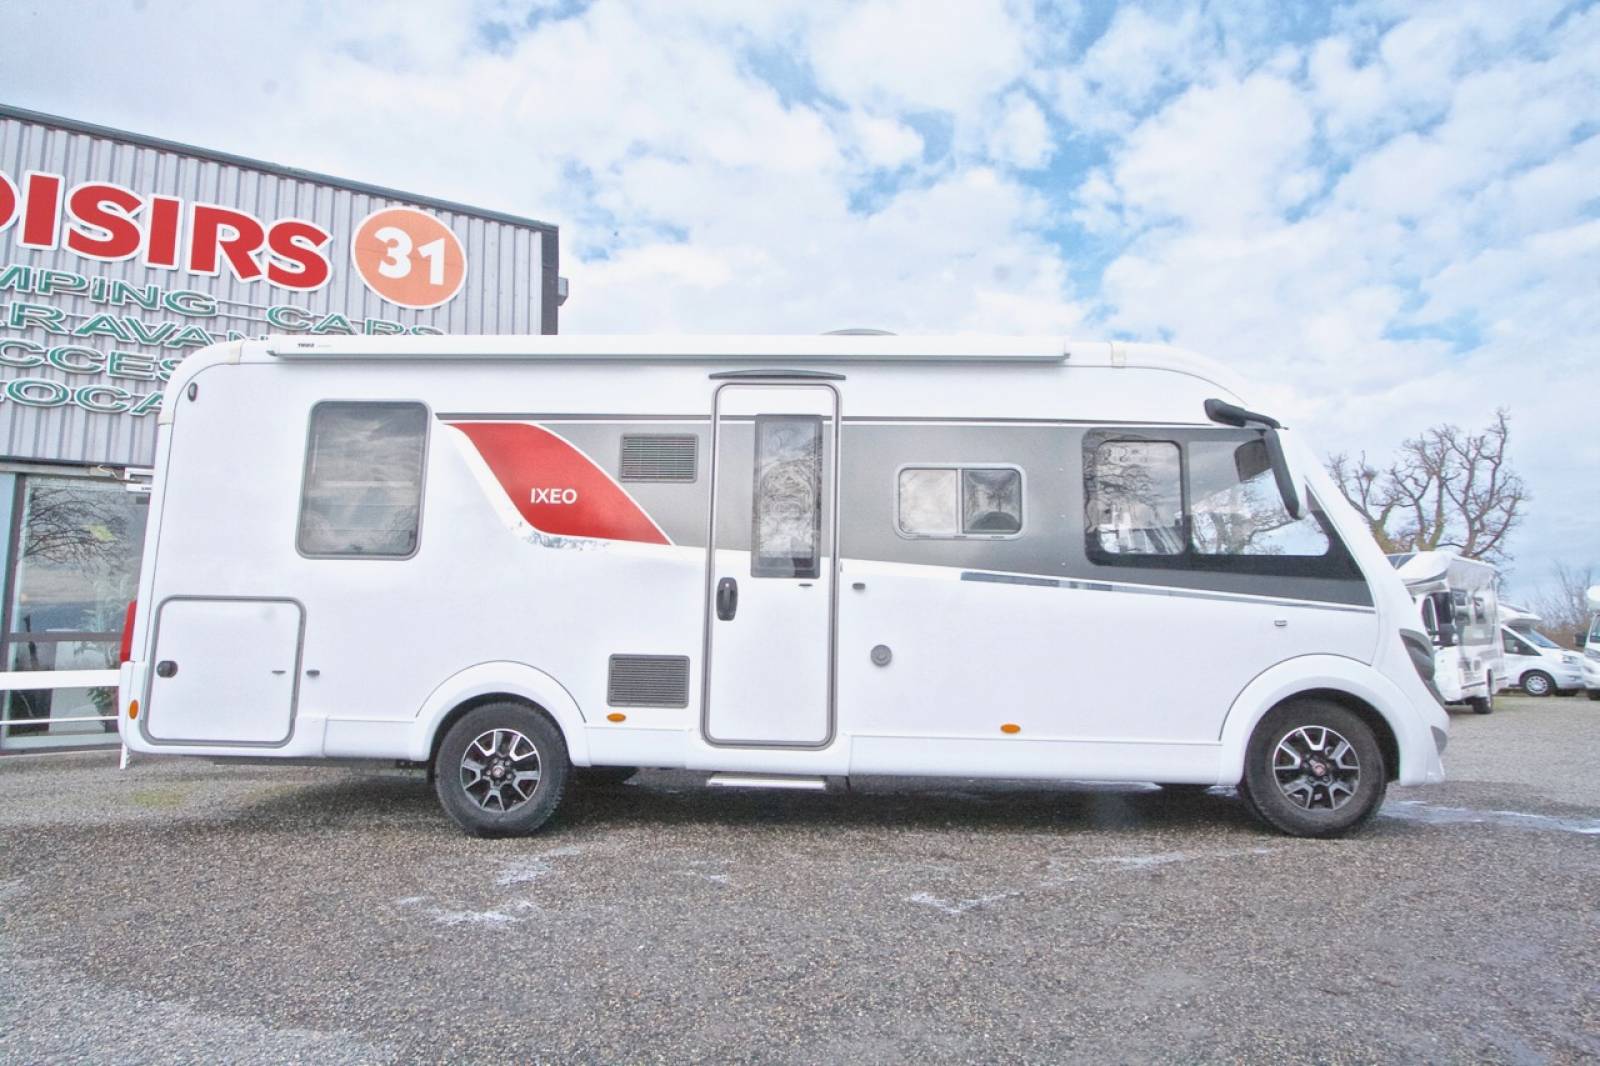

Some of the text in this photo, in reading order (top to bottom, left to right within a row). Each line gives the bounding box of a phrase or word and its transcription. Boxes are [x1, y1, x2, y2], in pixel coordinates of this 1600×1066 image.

[0, 171, 332, 291] ISIRS
[374, 226, 446, 286] 31
[530, 487, 578, 505] IXEO
